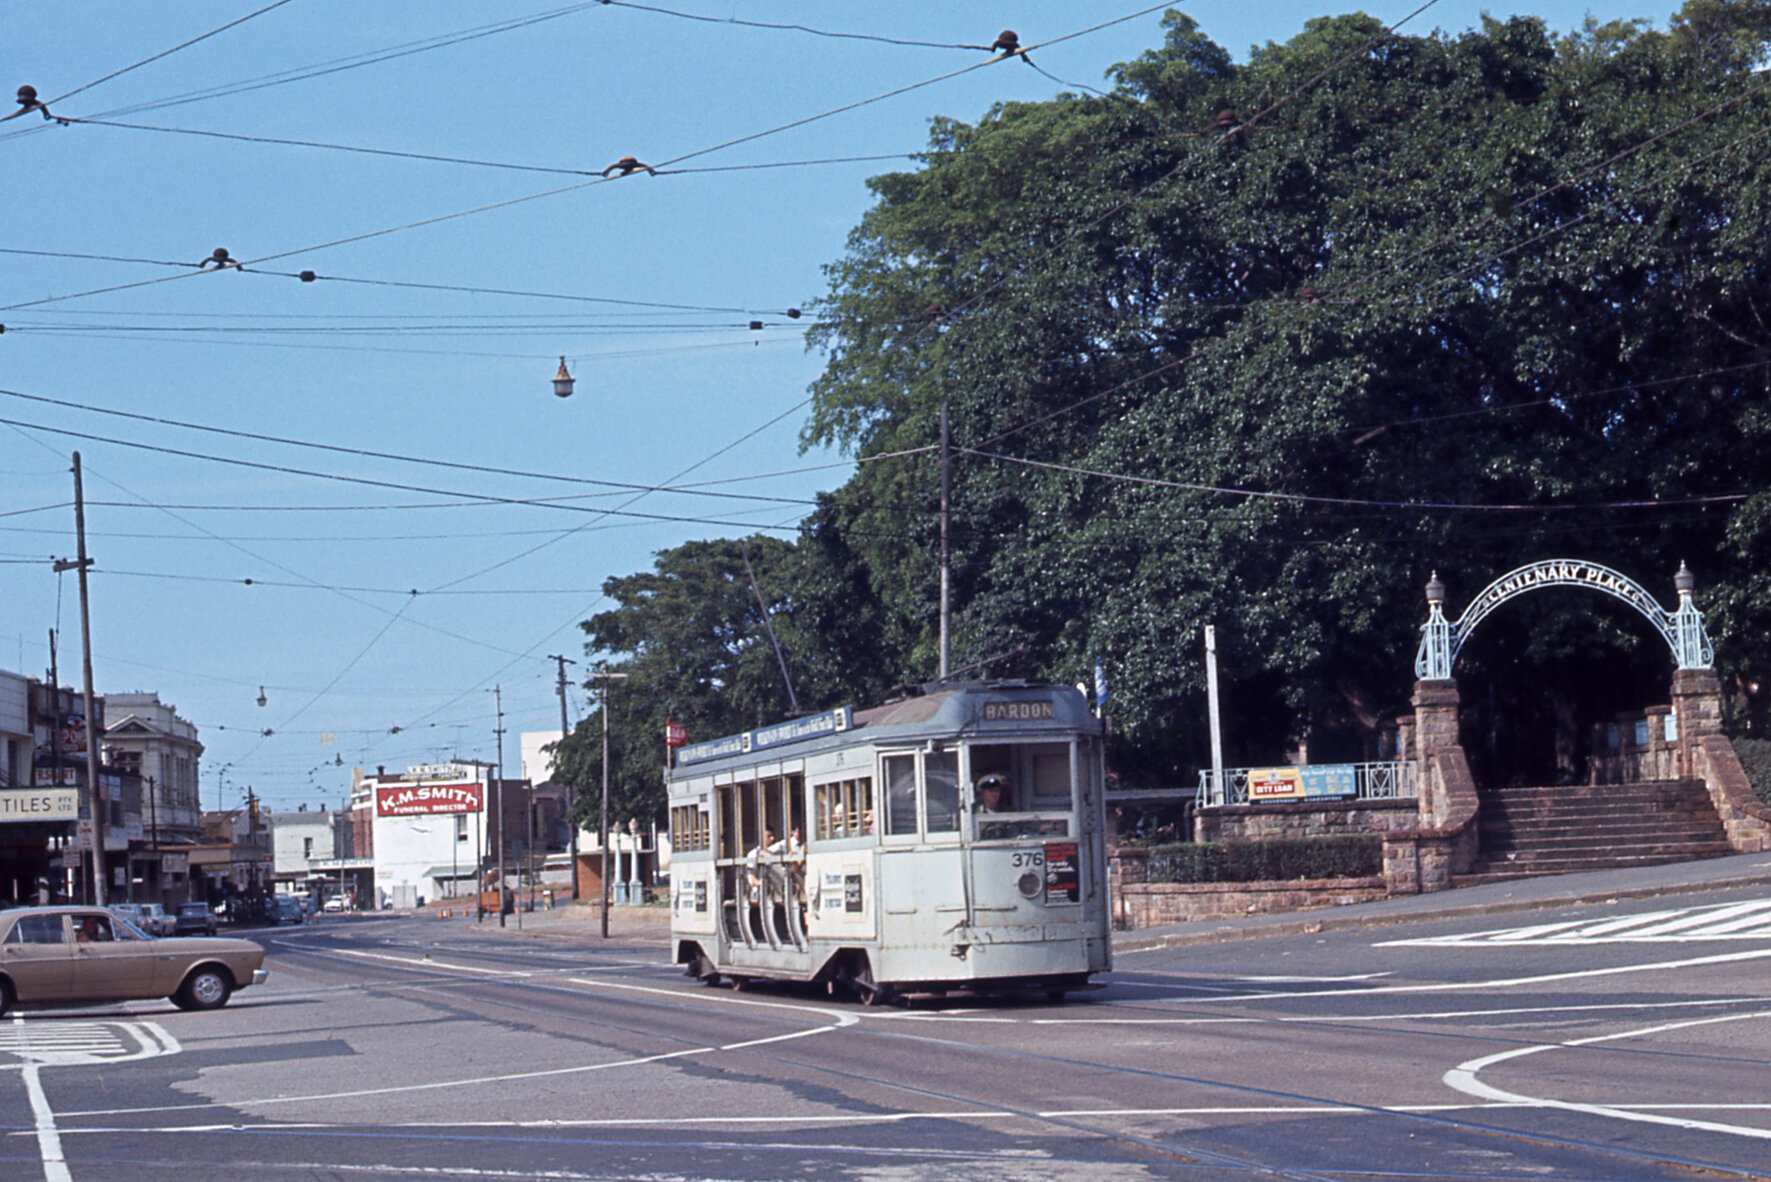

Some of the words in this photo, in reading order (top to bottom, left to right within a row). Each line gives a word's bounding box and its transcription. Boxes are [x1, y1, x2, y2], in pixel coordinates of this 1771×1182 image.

[1489, 565, 1580, 601] CENTENARY
[1586, 568, 1632, 597] PLACE
[986, 703, 1053, 719] BARDON
[3, 797, 51, 812] TILES
[394, 805, 429, 813] FUNERAL
[432, 804, 467, 812] DIRECTOR
[1012, 852, 1043, 867] 376
